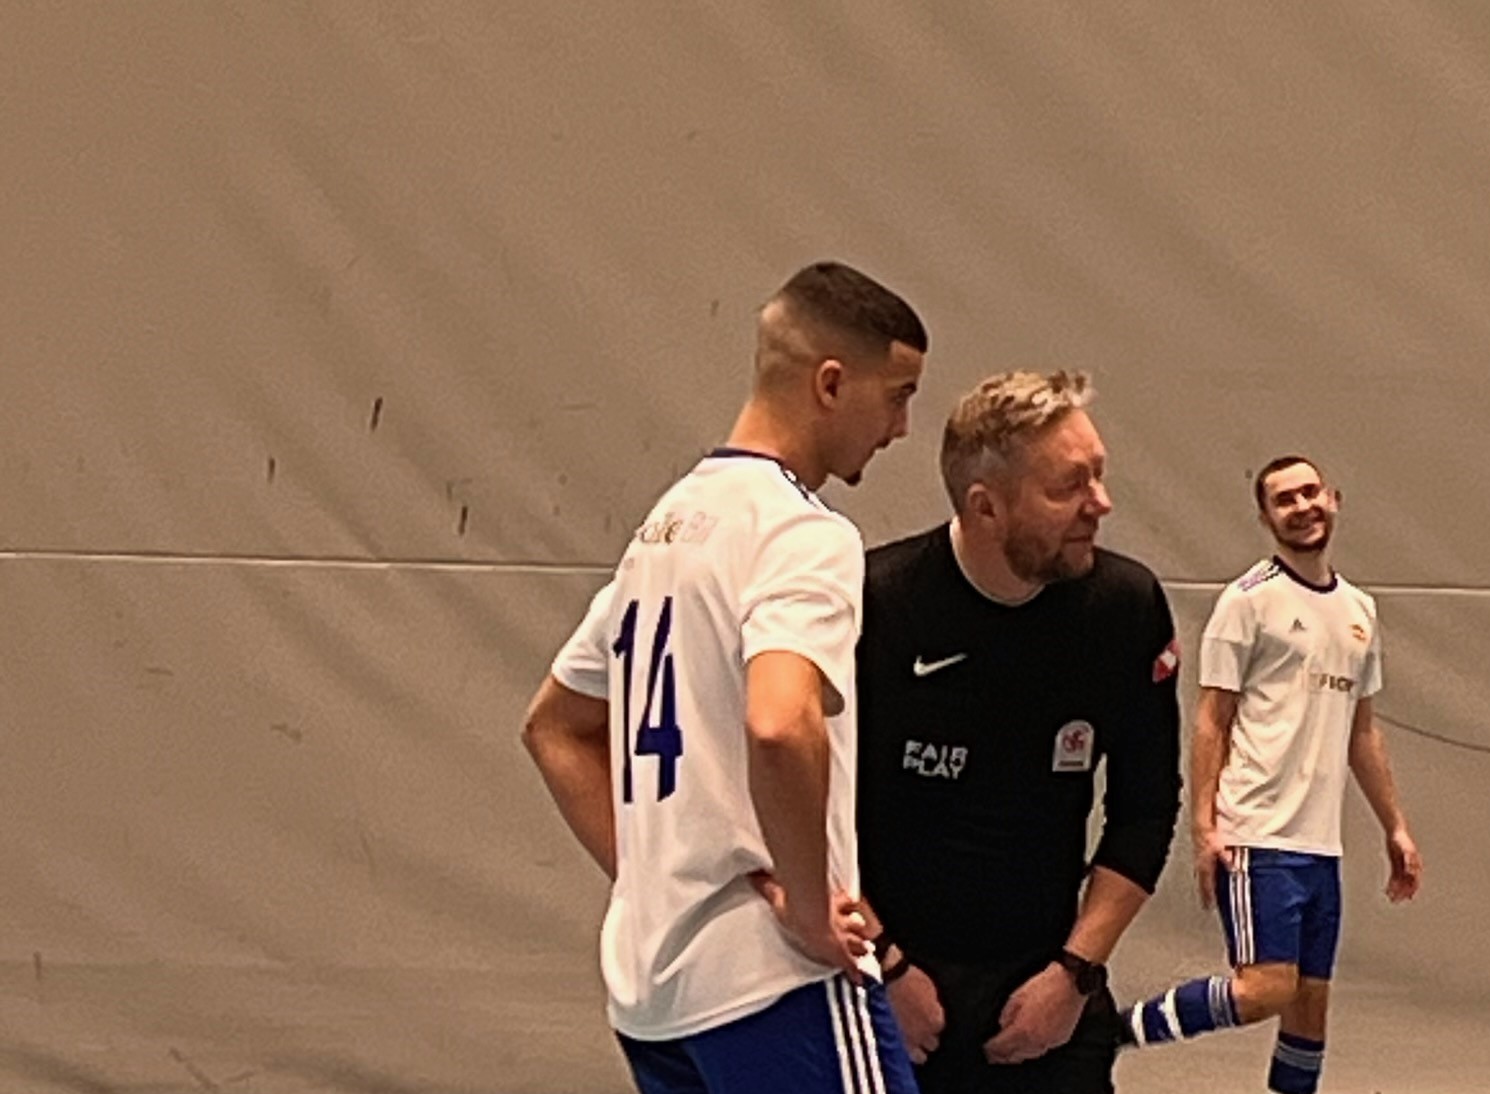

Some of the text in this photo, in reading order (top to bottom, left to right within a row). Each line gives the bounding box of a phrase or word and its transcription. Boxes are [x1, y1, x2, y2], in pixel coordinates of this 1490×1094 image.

[613, 596, 683, 802] 14
[905, 740, 968, 762] FAIR
[903, 755, 966, 779] PLAY
